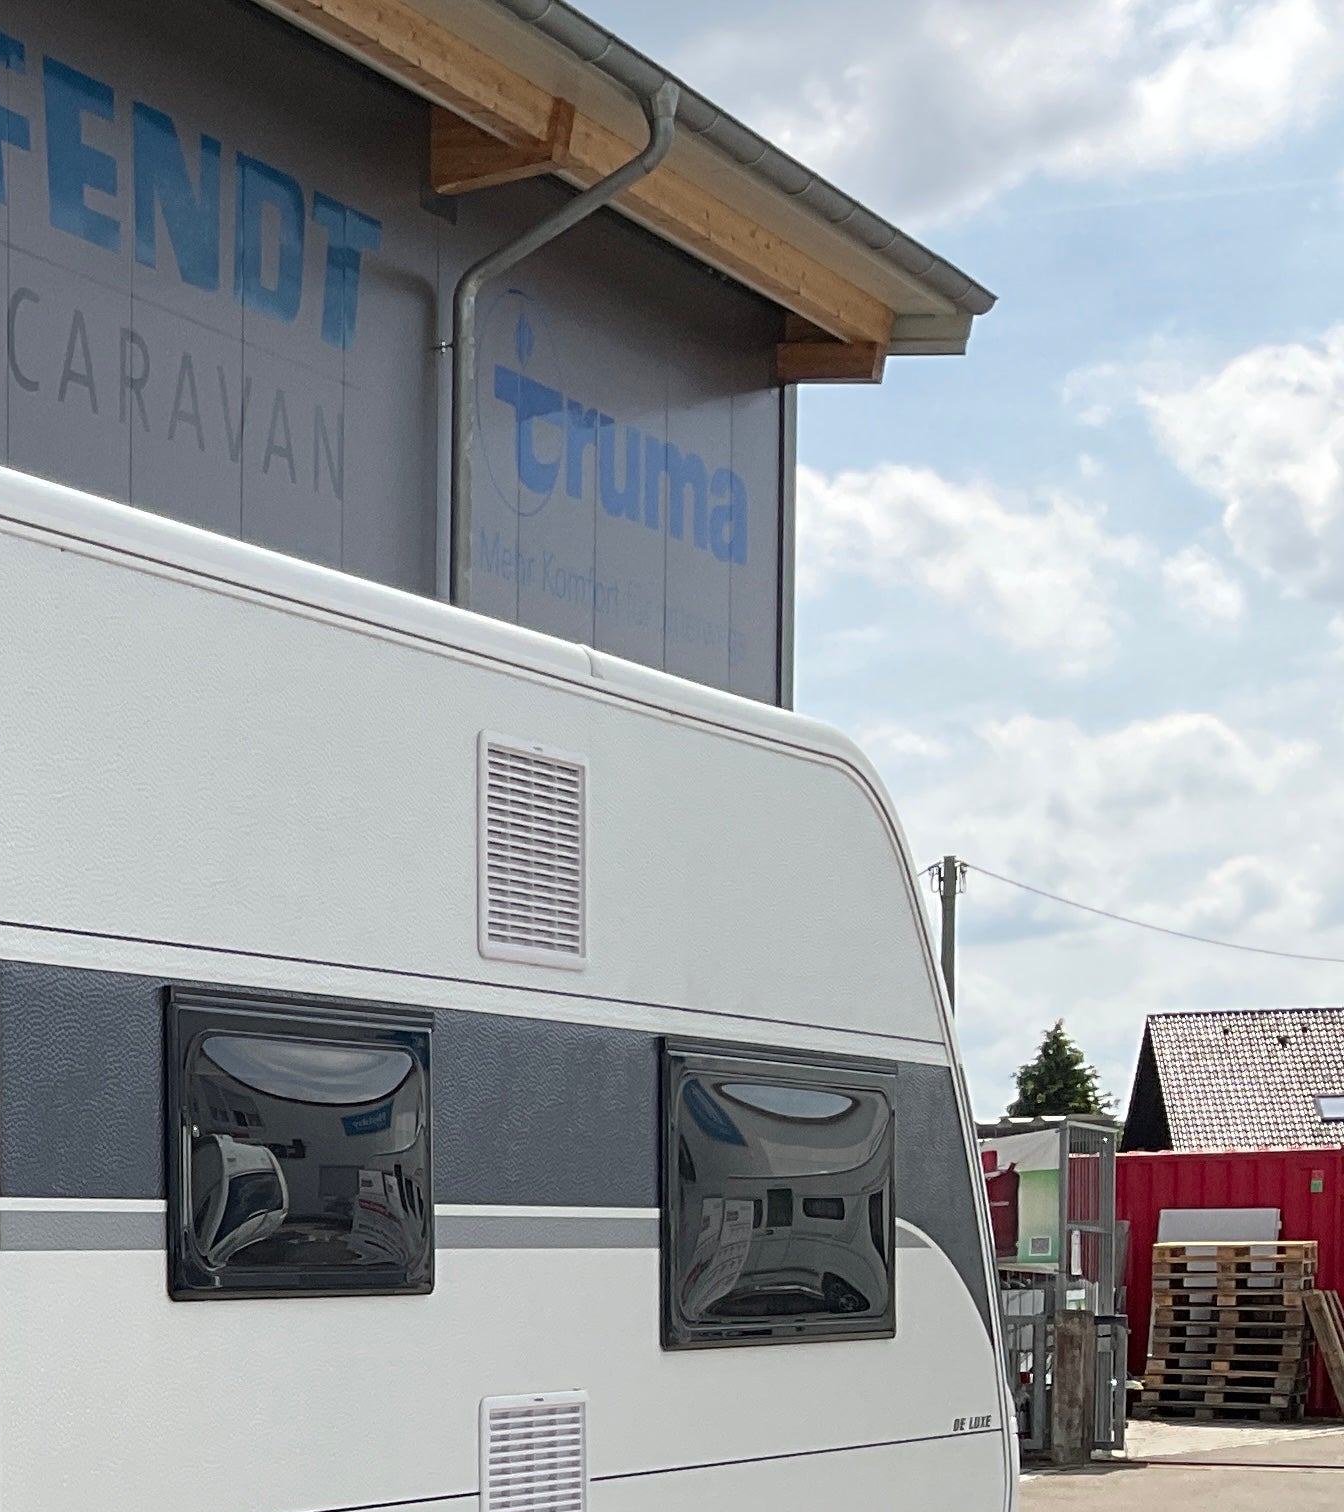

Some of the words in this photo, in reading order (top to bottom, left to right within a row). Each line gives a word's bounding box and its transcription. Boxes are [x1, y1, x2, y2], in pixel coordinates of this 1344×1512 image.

[8, 287, 343, 501] CARAVAN
[493, 364, 748, 566] truma
[480, 528, 535, 586] Mehr
[953, 1418, 966, 1431] DE
[969, 1415, 991, 1429] LUXE
